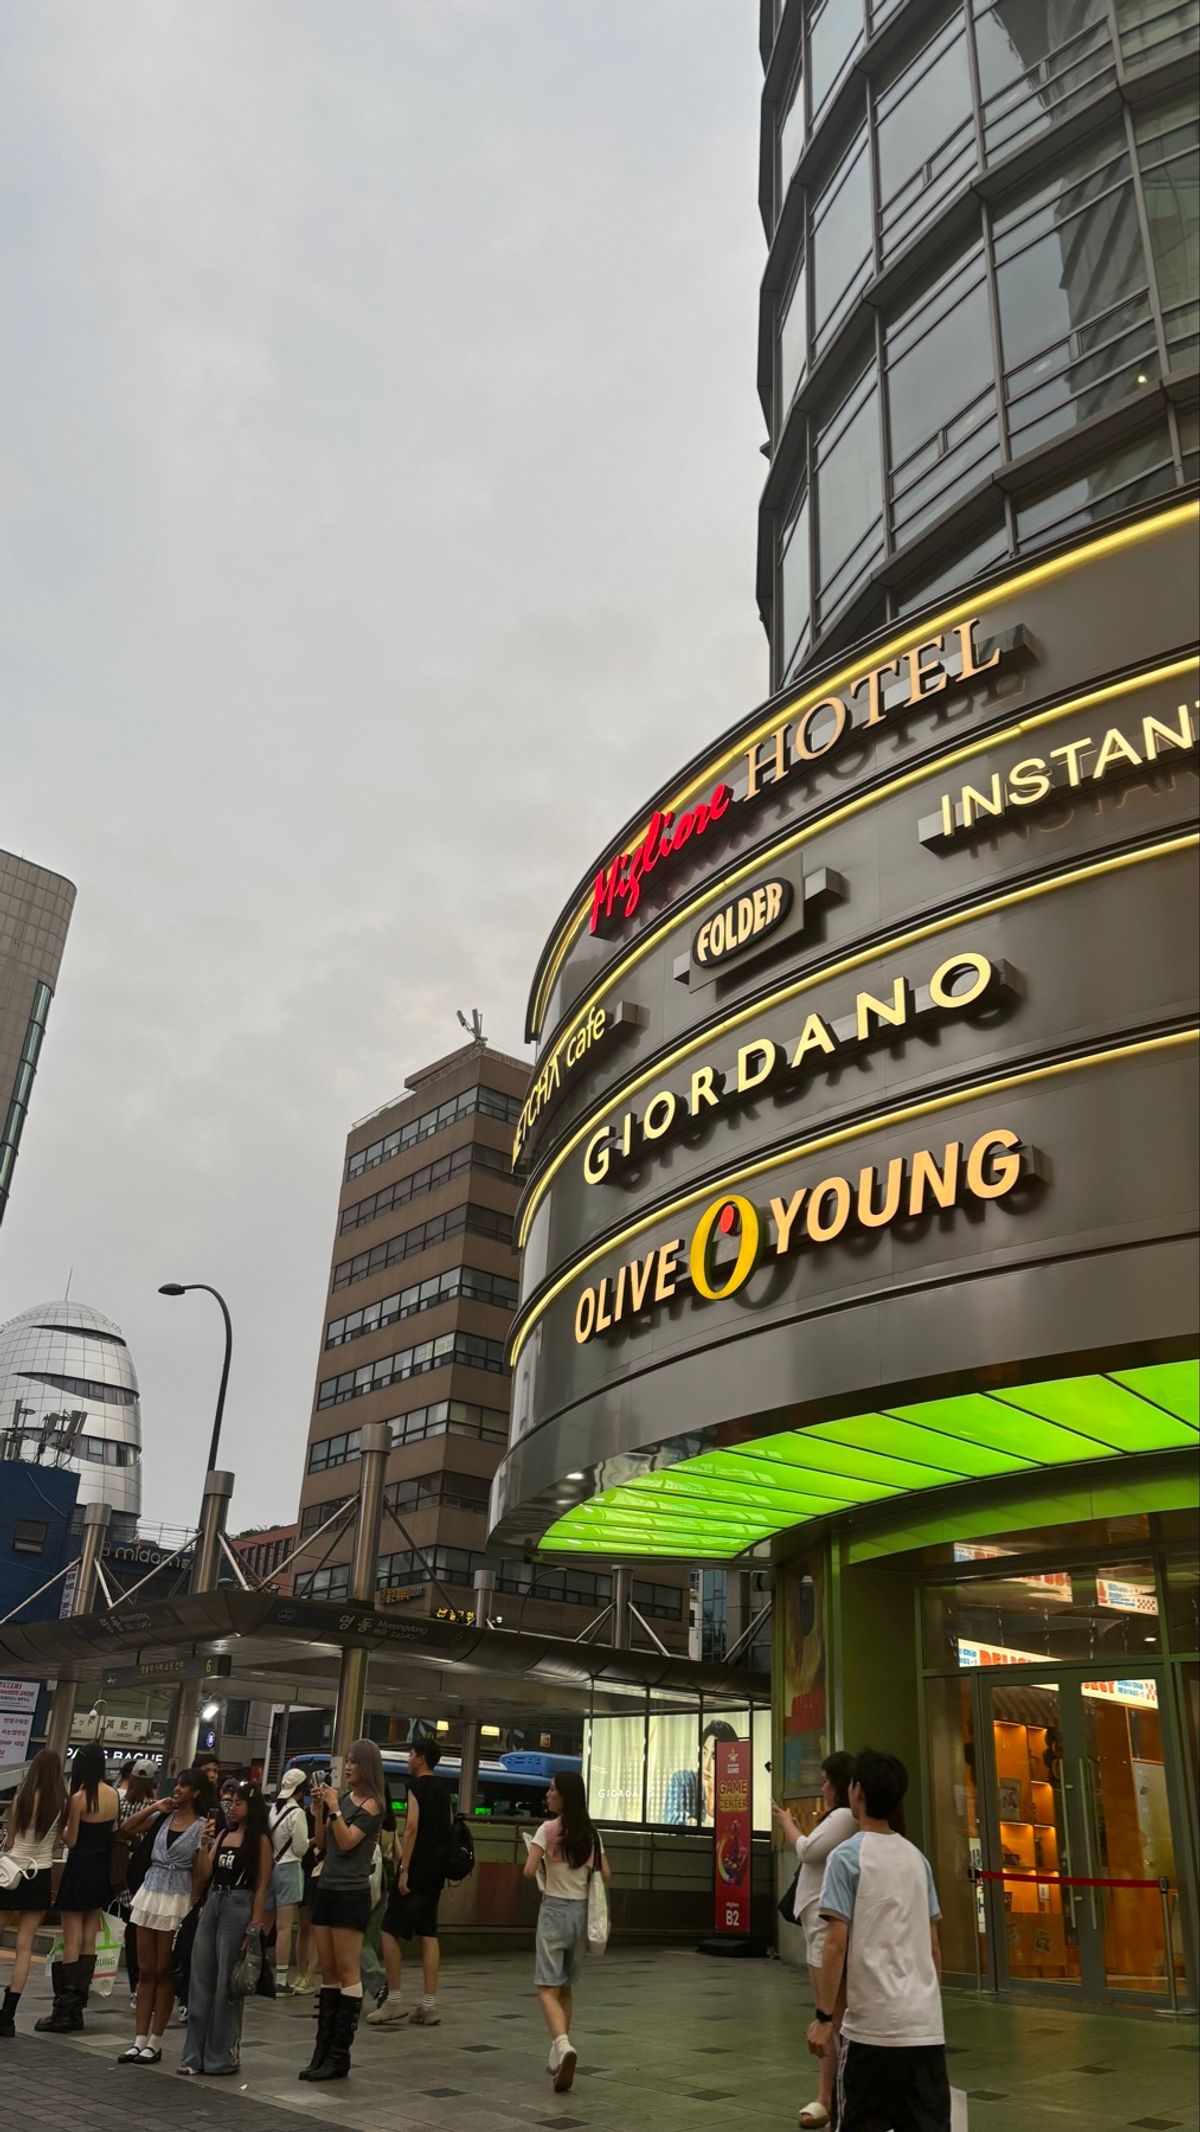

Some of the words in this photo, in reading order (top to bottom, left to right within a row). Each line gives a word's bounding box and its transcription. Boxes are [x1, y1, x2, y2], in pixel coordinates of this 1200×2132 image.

[588, 783, 735, 934] Migliore
[742, 618, 1001, 802] HOTEL
[941, 700, 1200, 837] INSTAN
[695, 881, 785, 964] FOLDER
[567, 1006, 606, 1068] cafe
[583, 952, 992, 1186] GIORDANO
[574, 1239, 685, 1345] OLIVE
[769, 1128, 1022, 1255] YOUNG
[205, 1659, 212, 1673] 6
[598, 1787, 655, 1799] GIORDAO
[719, 1779, 748, 1796] GAME
[719, 1798, 749, 1810] CENTER
[725, 1909, 740, 1927] B2
